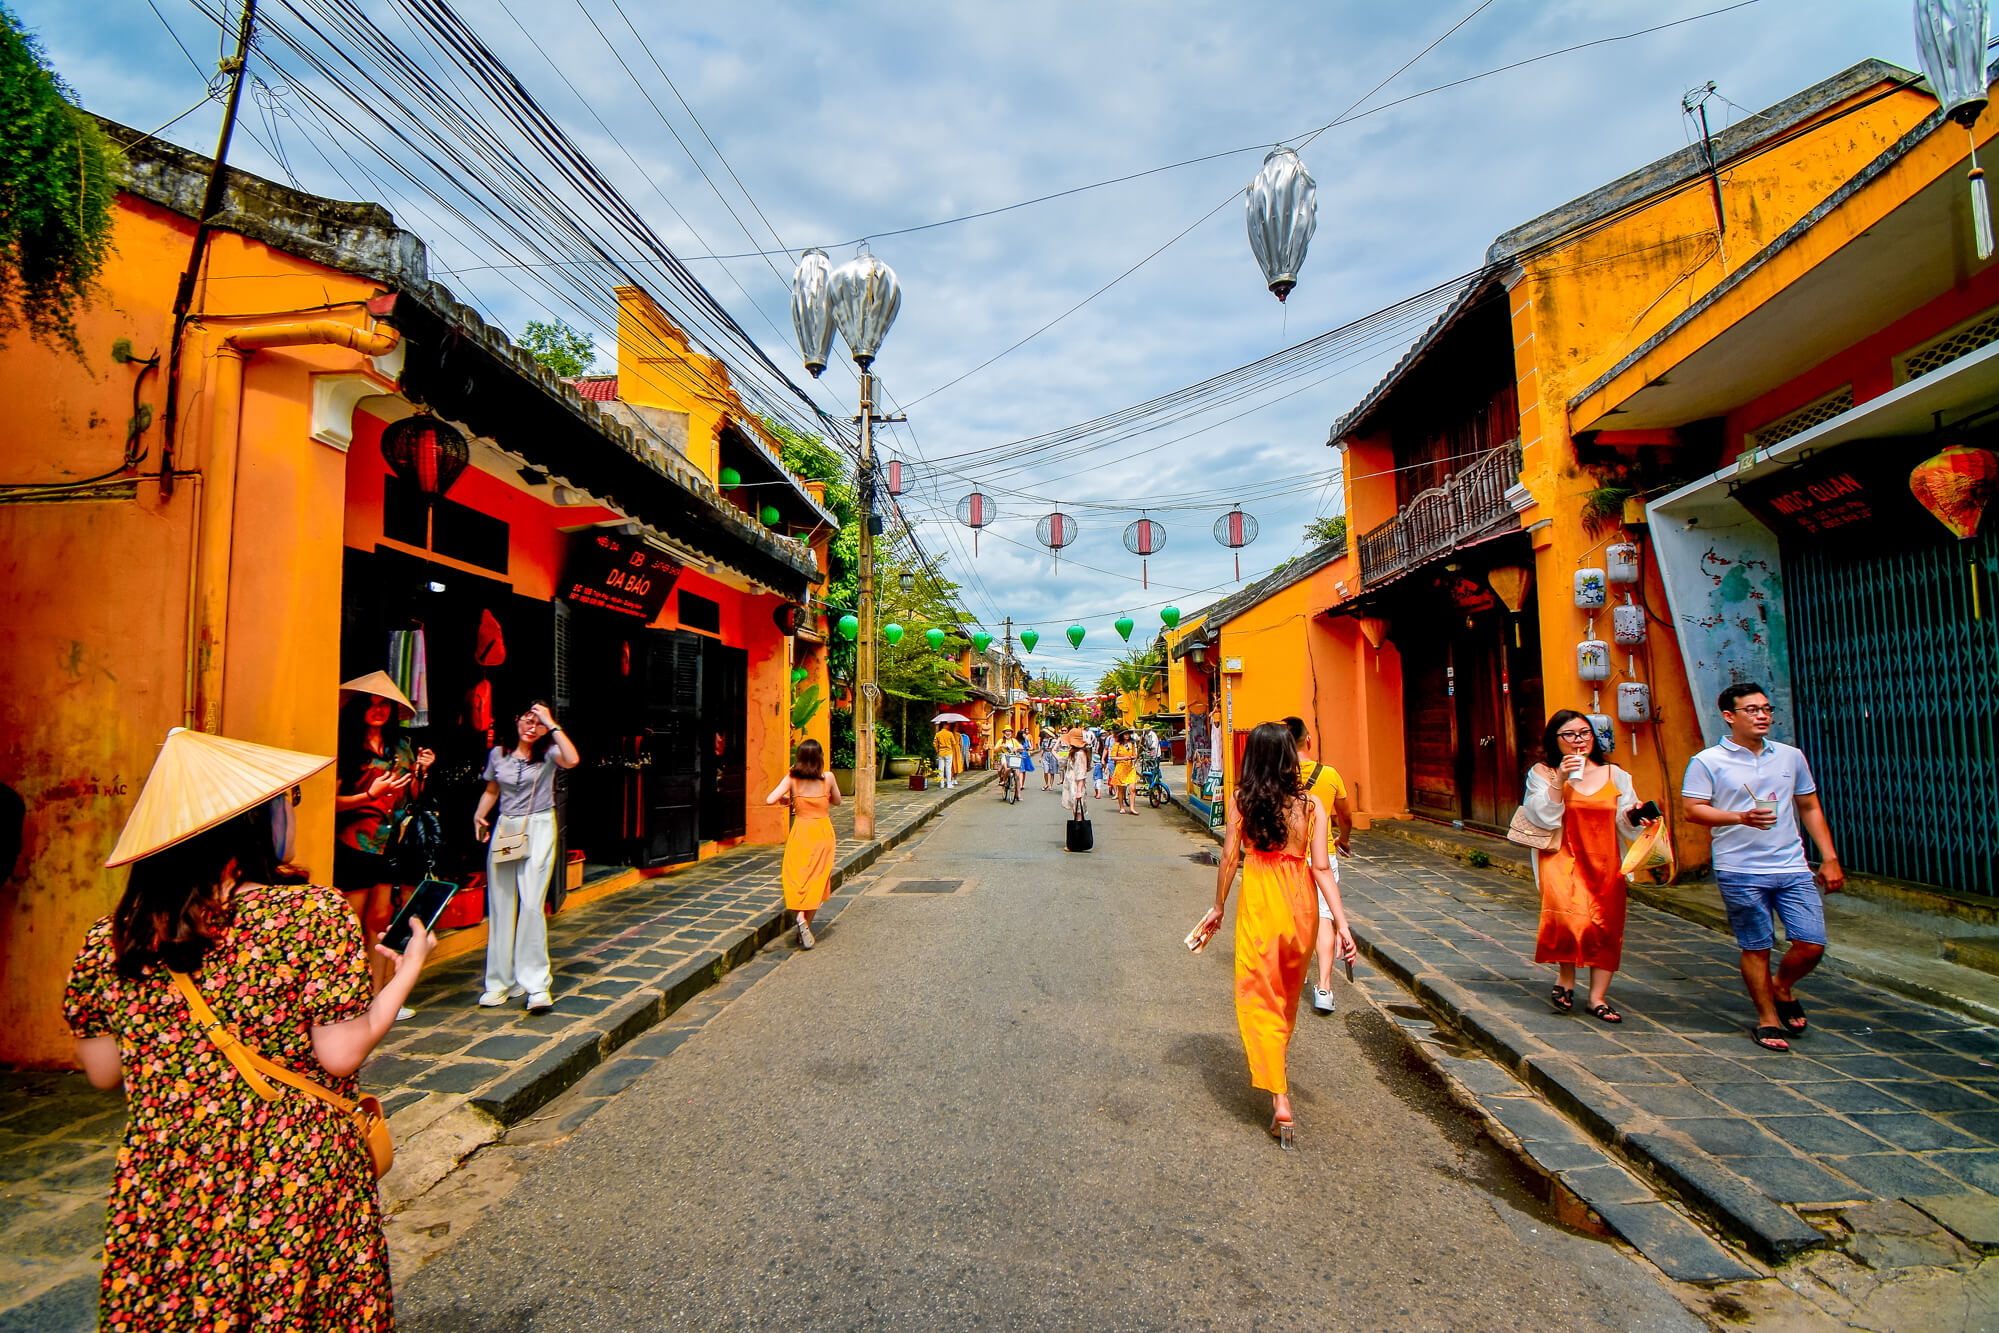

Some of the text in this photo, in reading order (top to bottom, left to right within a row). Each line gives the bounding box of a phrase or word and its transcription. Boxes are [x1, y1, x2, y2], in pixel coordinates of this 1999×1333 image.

[629, 551, 645, 567] DB
[606, 568, 626, 589] DA
[103, 774, 128, 797] RÁC
